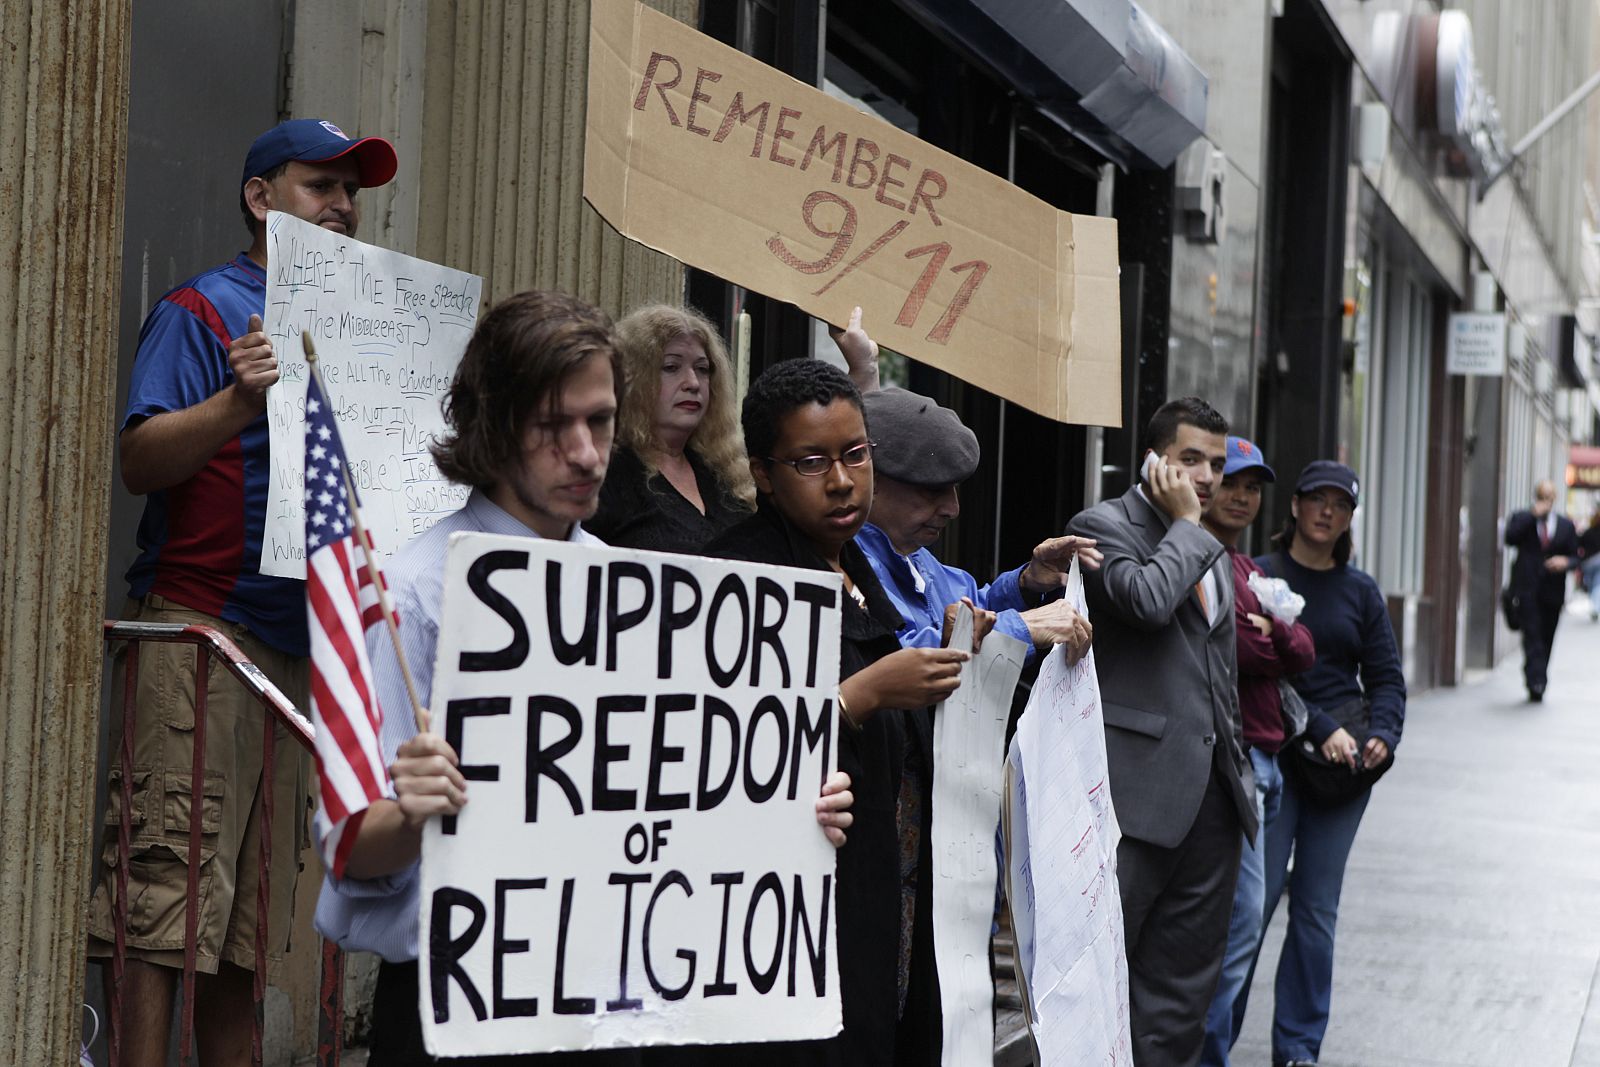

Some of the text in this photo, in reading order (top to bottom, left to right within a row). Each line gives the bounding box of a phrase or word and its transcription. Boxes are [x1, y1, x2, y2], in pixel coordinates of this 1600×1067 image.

[632, 51, 948, 227] REMEMBER
[766, 190, 991, 346] 9/11
[458, 549, 836, 689] SUPPORT
[441, 693, 832, 835] FREEDOM
[624, 820, 672, 864] OF
[429, 869, 831, 1024] RELIGION
